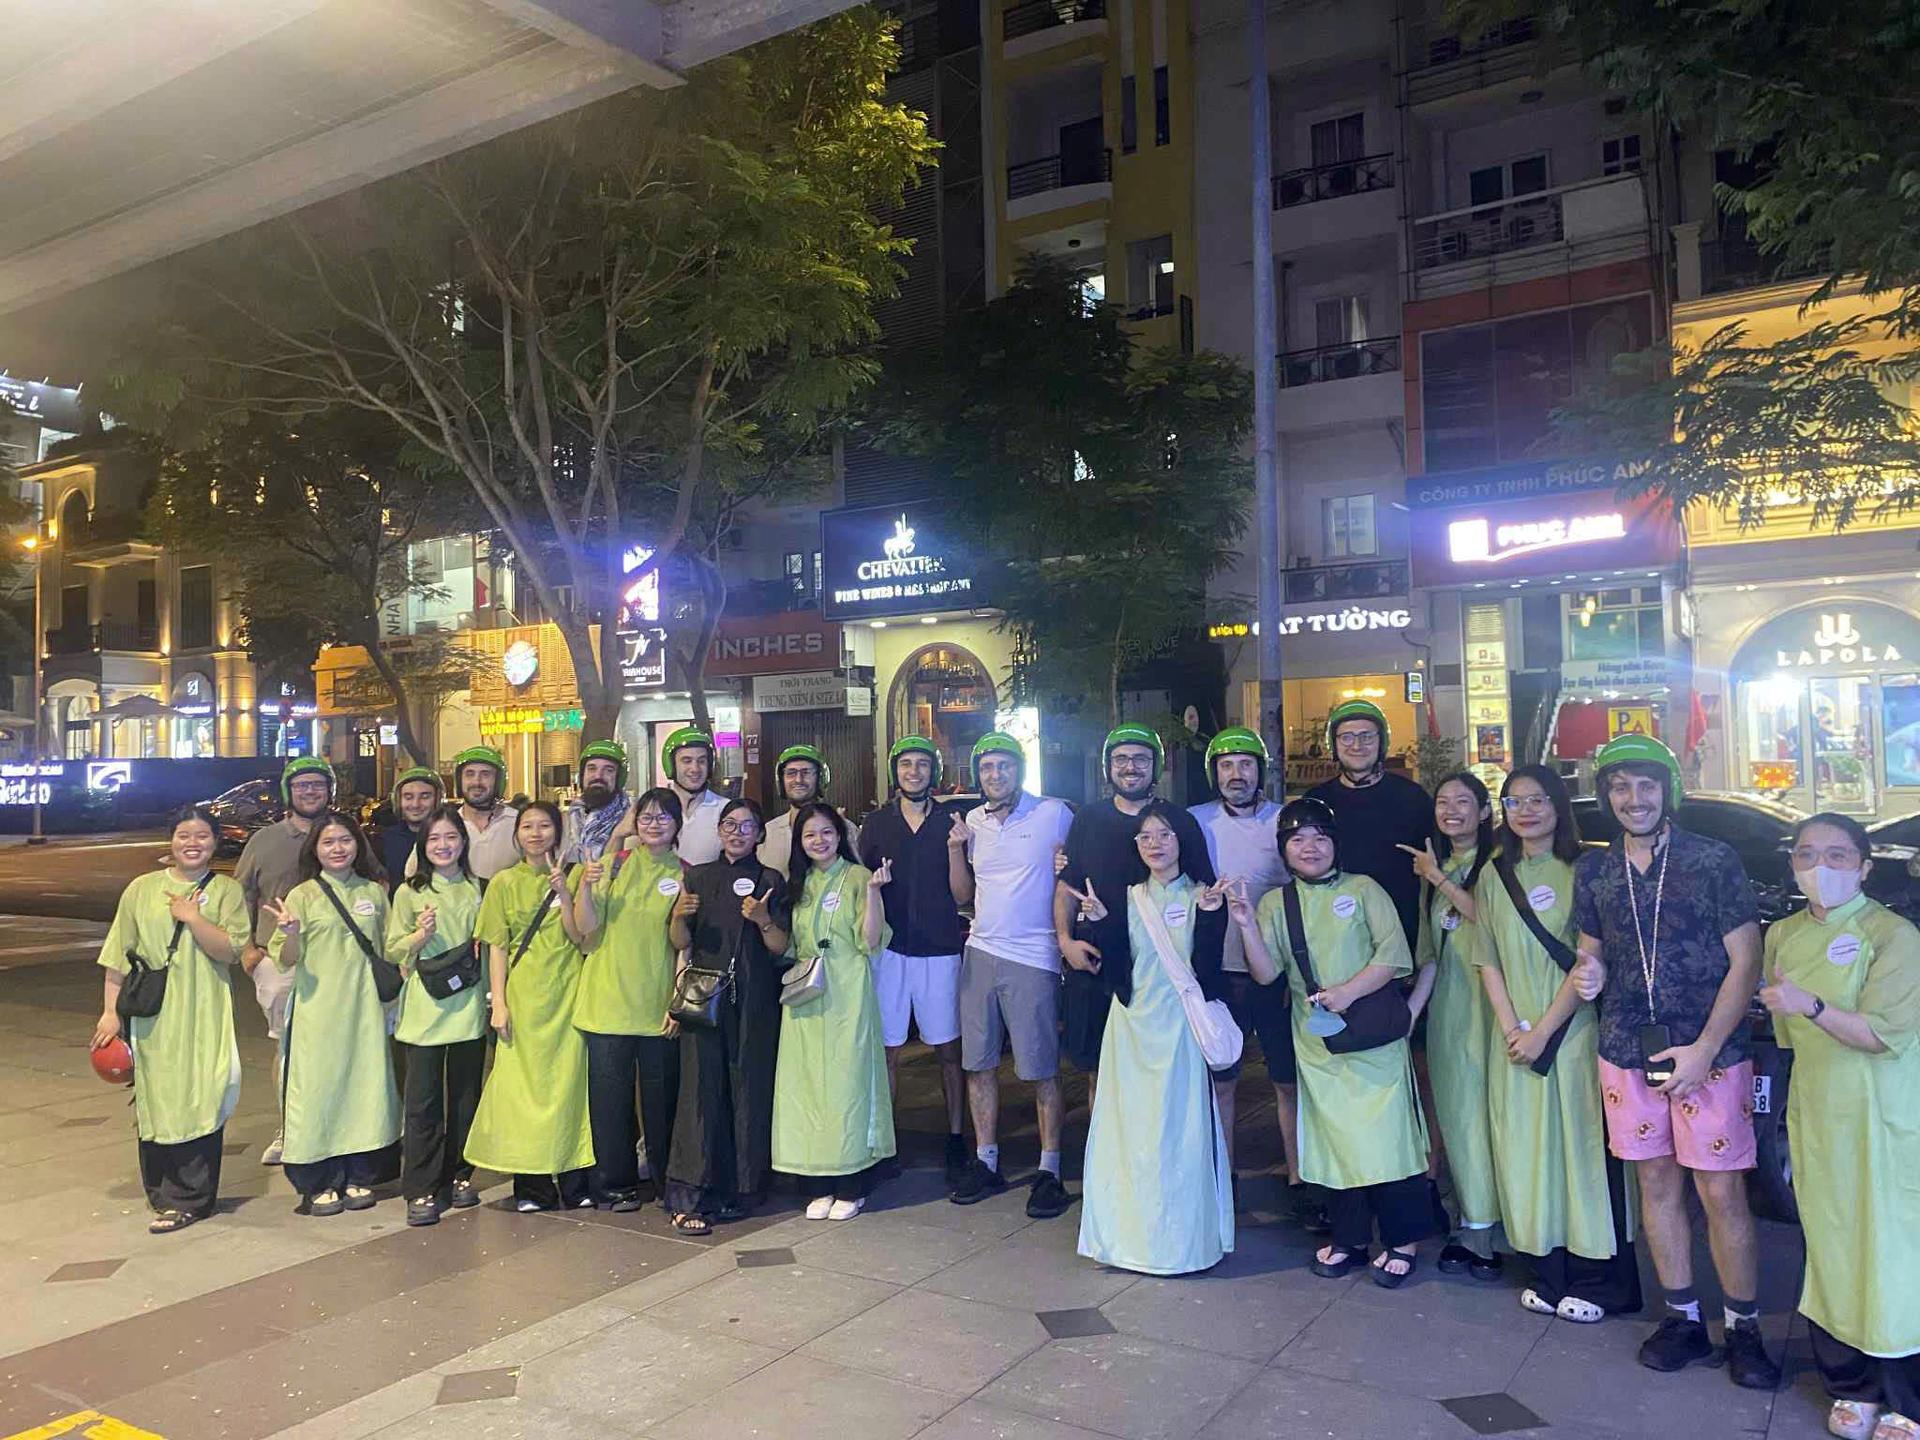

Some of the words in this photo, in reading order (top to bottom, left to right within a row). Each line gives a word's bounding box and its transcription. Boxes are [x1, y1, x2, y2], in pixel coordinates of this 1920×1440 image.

[1474, 482, 1490, 496] TY
[1307, 607, 1411, 632] TƯỜNG
[1777, 644, 1901, 666] LAPOLA
